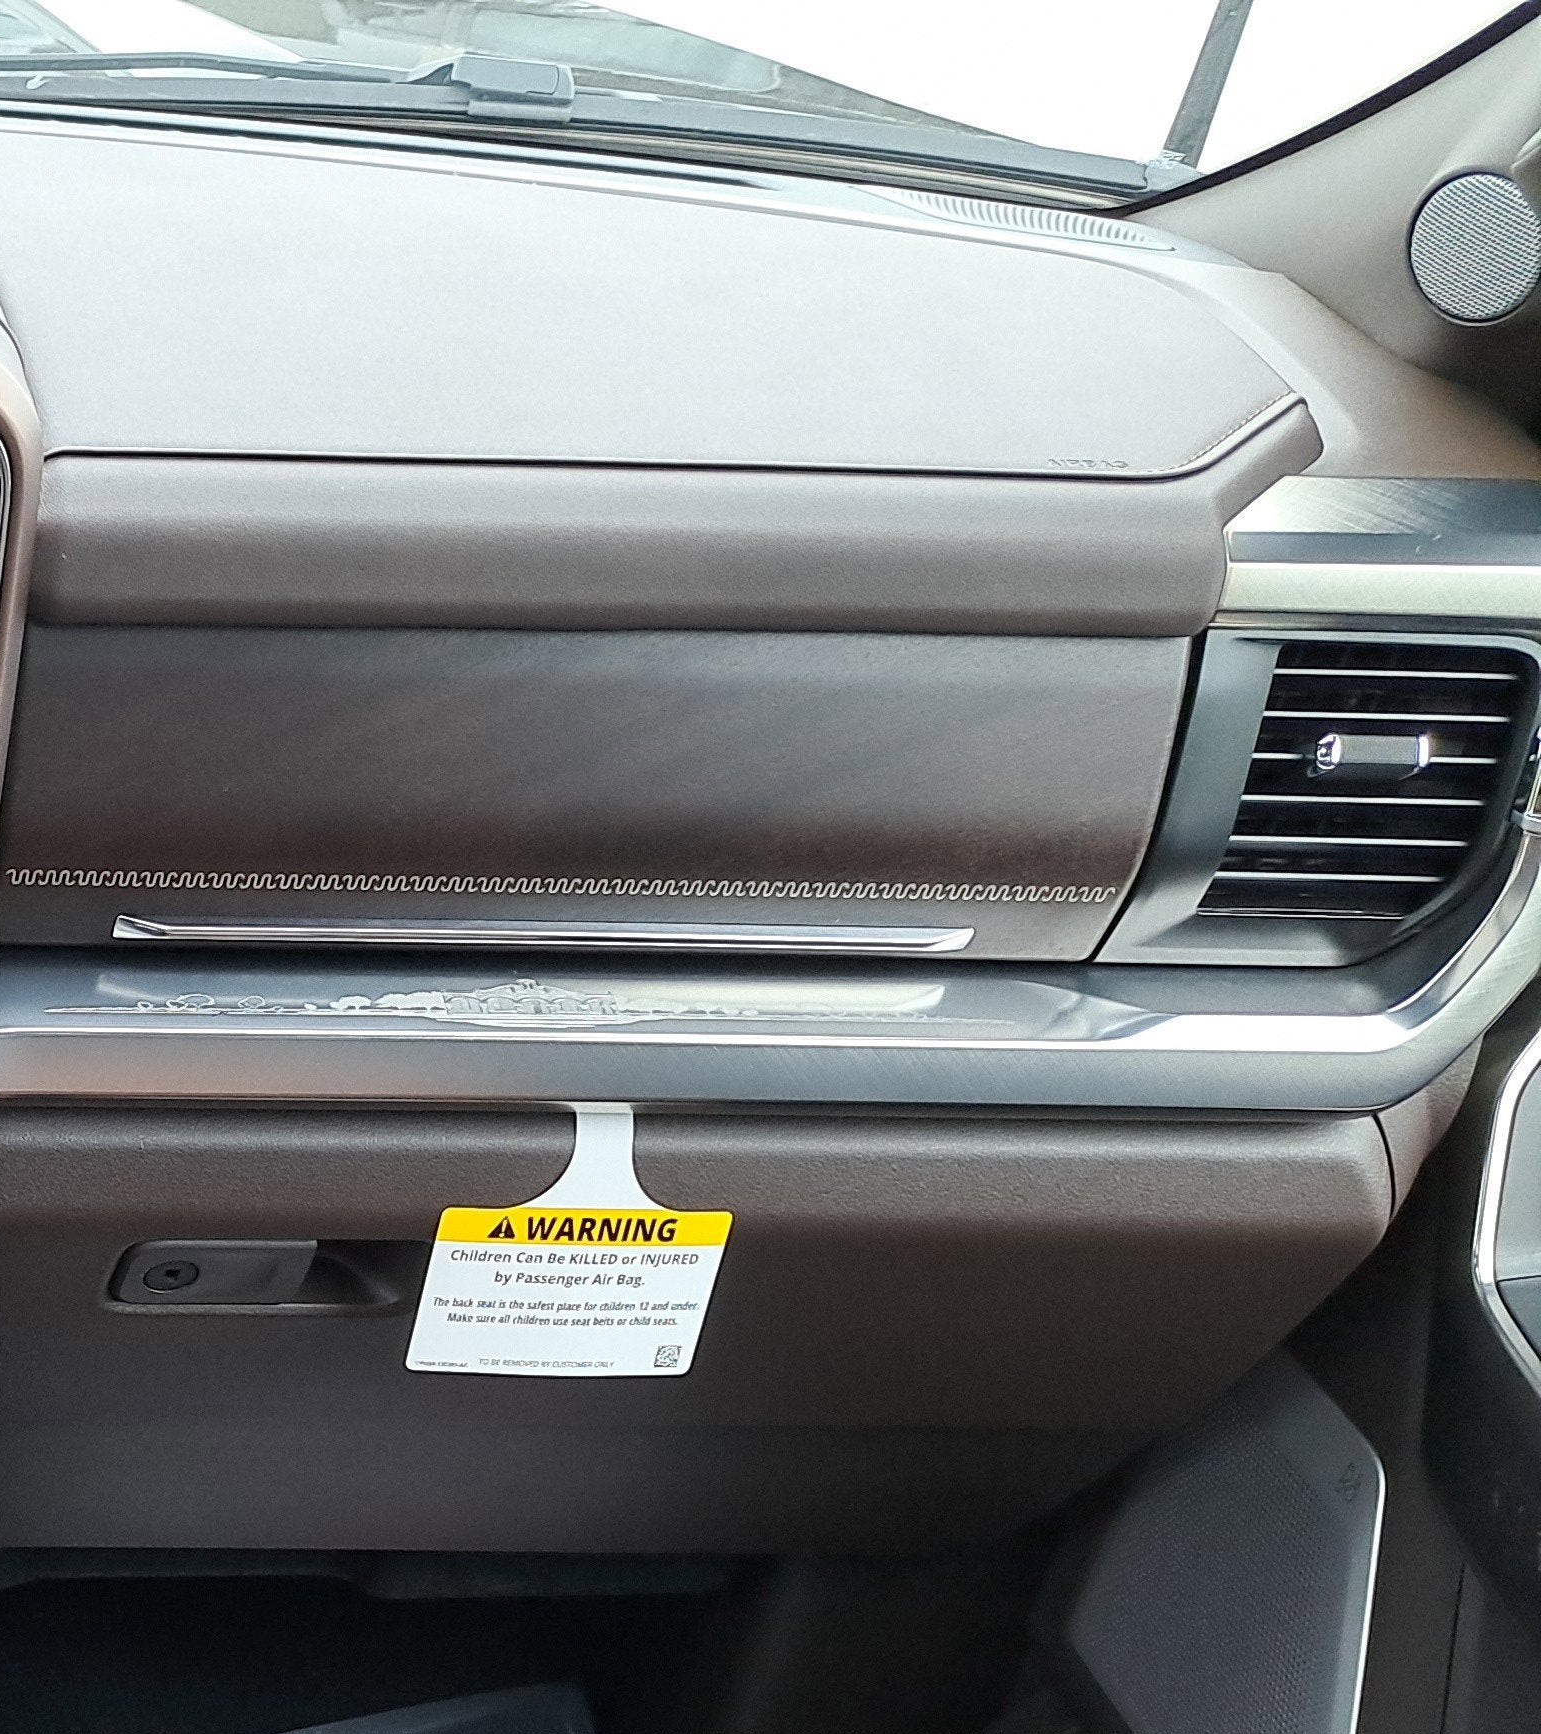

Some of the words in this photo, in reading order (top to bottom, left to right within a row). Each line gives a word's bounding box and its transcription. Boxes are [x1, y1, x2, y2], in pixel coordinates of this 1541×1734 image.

[526, 1216, 679, 1242] WARNING
[450, 1249, 511, 1263] Children
[516, 1252, 542, 1264] Can
[547, 1253, 565, 1264] Be
[568, 1253, 617, 1265] KILLED
[621, 1255, 638, 1265] or
[640, 1253, 699, 1266] INJURED
[494, 1272, 511, 1286] by
[515, 1272, 590, 1288] Passenger
[591, 1273, 614, 1285] Air
[616, 1274, 645, 1288] Bag.
[433, 1297, 449, 1307] The
[452, 1297, 473, 1307] back
[477, 1299, 496, 1308] seat
[498, 1299, 506, 1308] is
[509, 1300, 524, 1309] the
[527, 1300, 555, 1311] safest
[556, 1301, 581, 1313] place
[584, 1301, 597, 1310] for
[600, 1301, 635, 1311] children
[639, 1302, 649, 1310] 12
[651, 1302, 667, 1310] and
[447, 1313, 473, 1322] Make
[476, 1315, 496, 1323] sure
[498, 1314, 510, 1323] all
[513, 1315, 550, 1325] children
[571, 1318, 590, 1326] seat
[593, 1317, 614, 1326] belts
[617, 1318, 626, 1326] or
[629, 1317, 650, 1326] child
